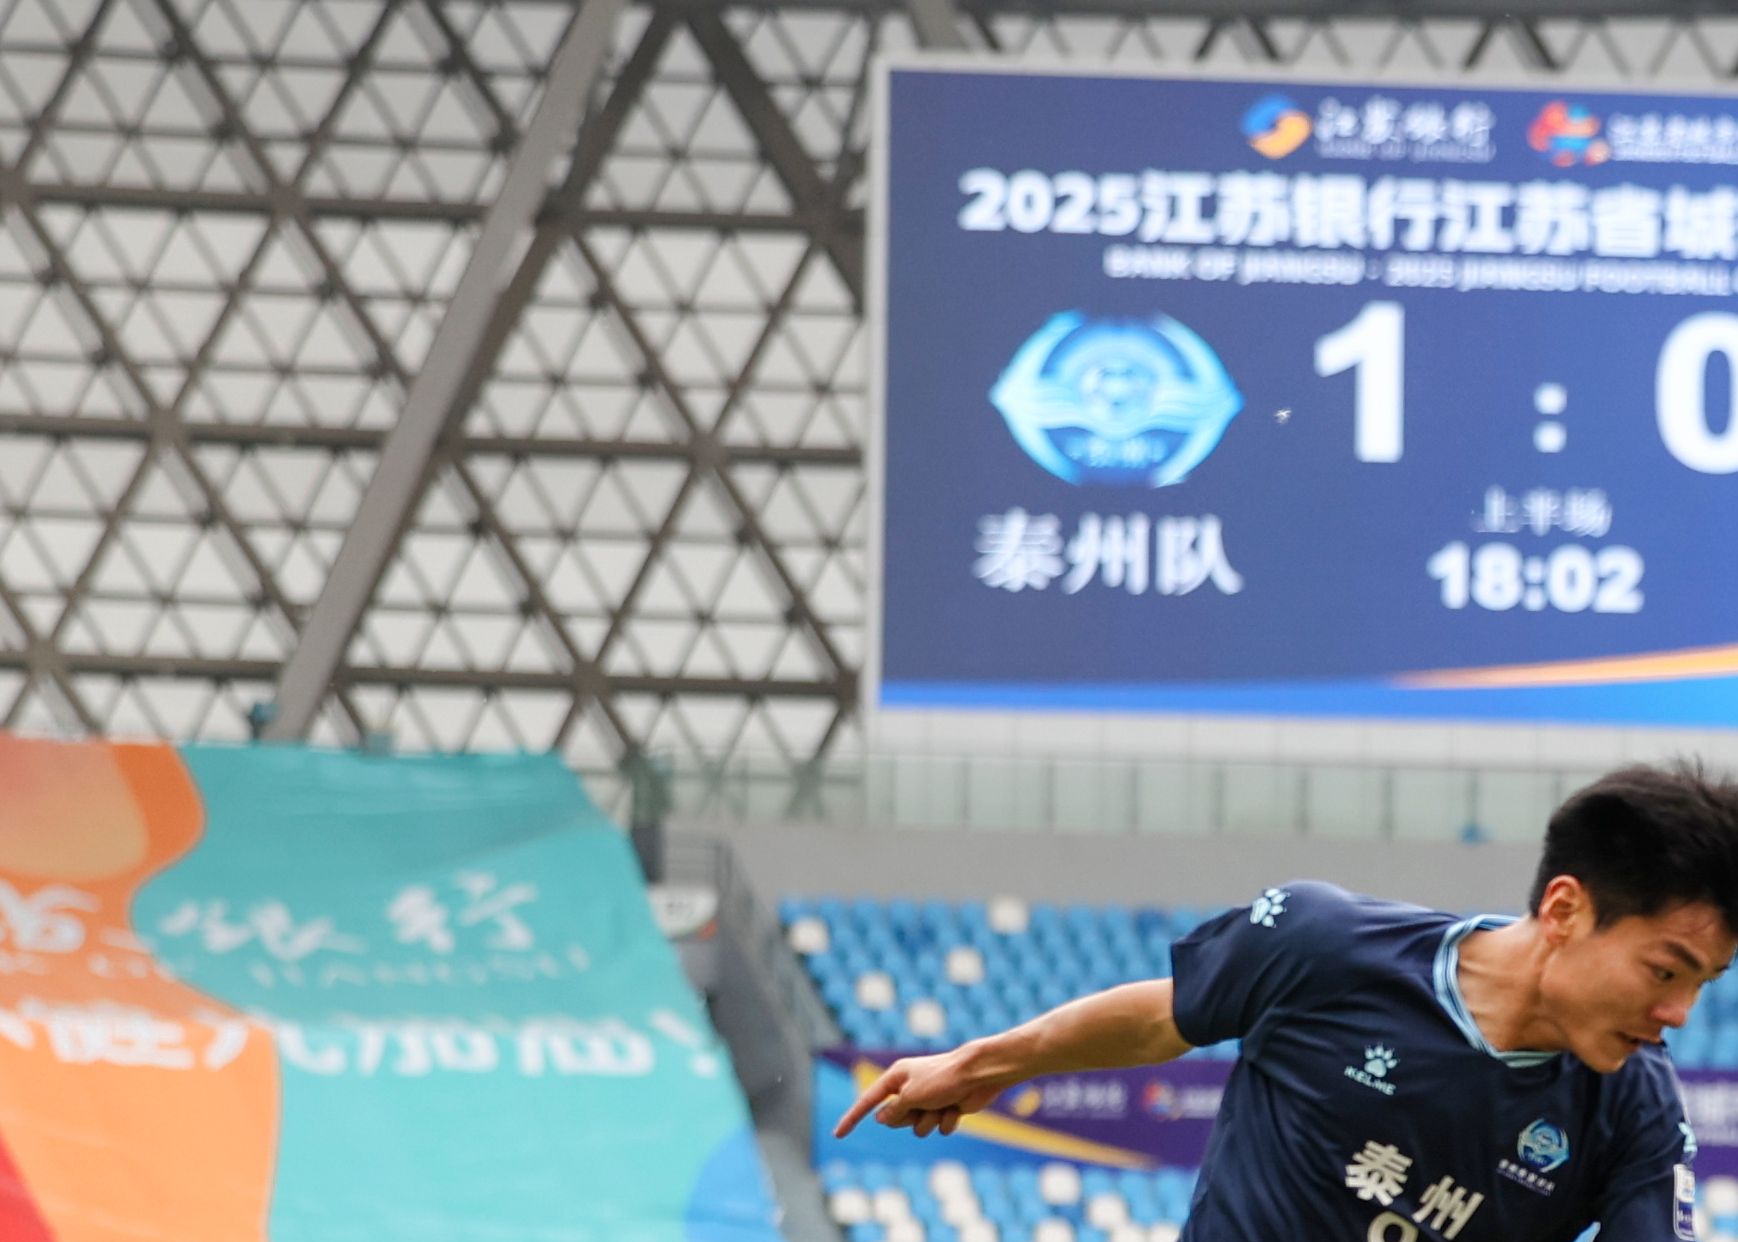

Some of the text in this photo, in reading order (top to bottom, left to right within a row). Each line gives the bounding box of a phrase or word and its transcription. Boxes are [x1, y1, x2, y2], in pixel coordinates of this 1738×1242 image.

[1313, 300, 1405, 463] 1
[973, 507, 1243, 594] 泰州队
[1425, 541, 1645, 614] 18:02
[1343, 1065, 1397, 1096] KELME
[1345, 1139, 1484, 1241] 泰州
